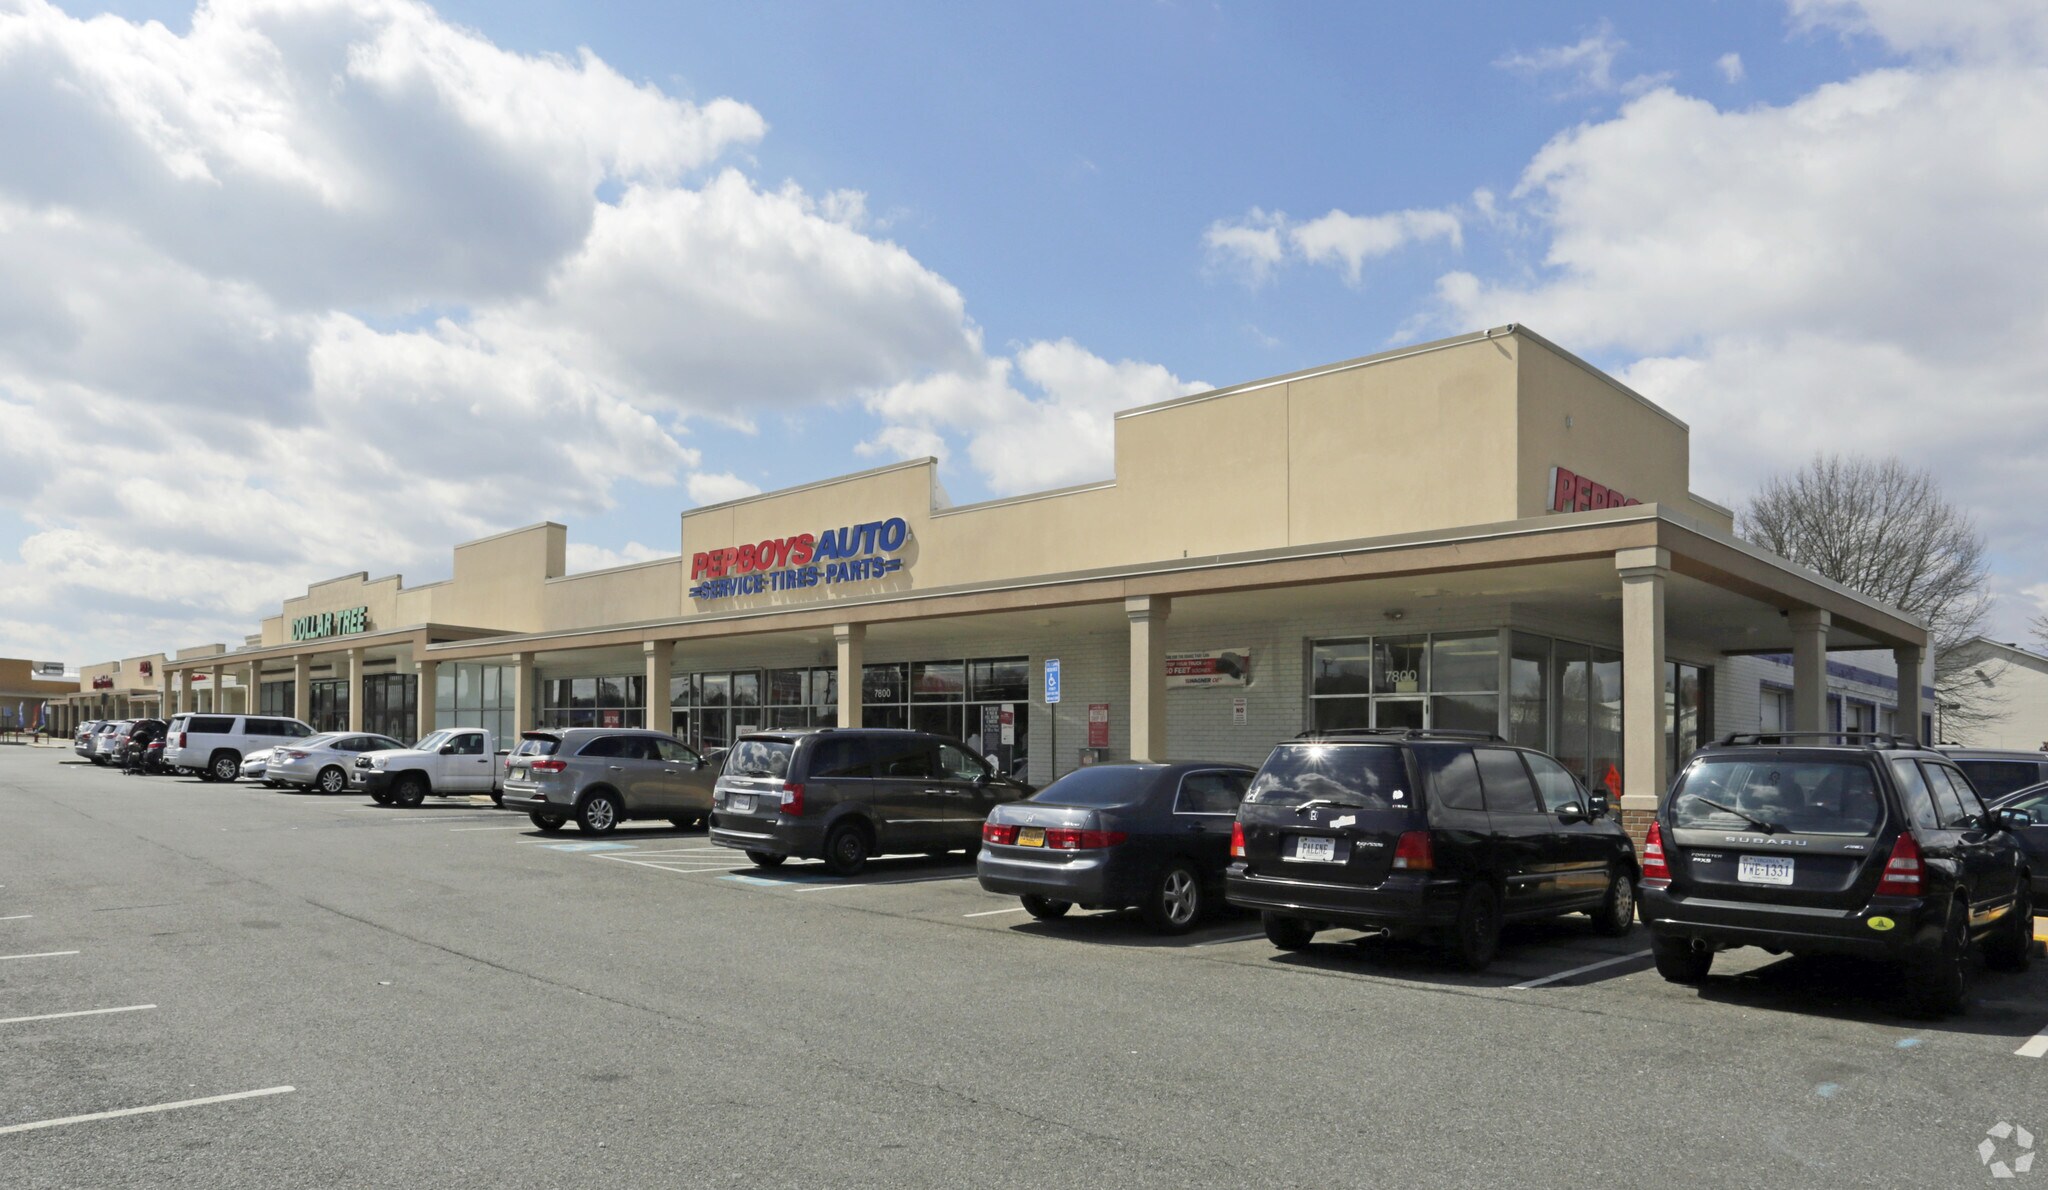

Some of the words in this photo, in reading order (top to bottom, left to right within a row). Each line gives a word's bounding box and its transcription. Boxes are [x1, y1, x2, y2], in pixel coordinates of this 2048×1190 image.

[812, 517, 907, 563] AUTO
[292, 611, 333, 641] DOLLAR
[336, 607, 367, 635] TREE
[1385, 670, 1417, 683] 7800
[874, 688, 891, 698] 7800
[1725, 836, 1807, 846] SUBARU
[1742, 863, 1789, 878] VWE-1331
